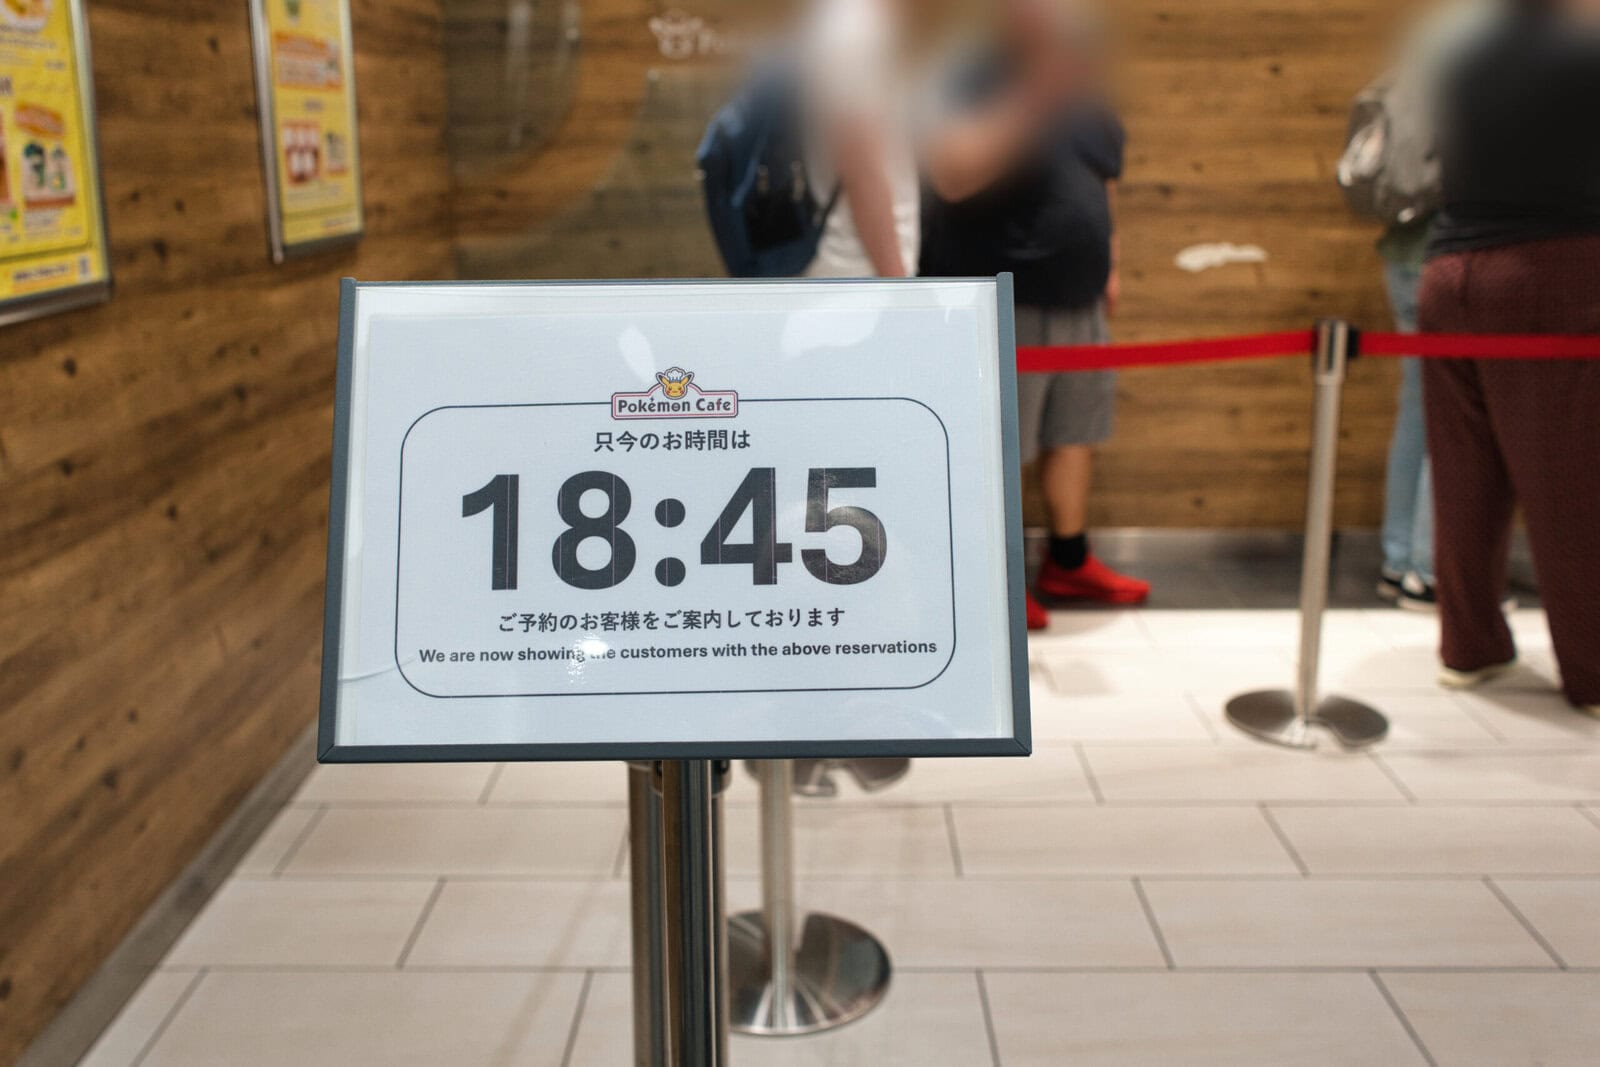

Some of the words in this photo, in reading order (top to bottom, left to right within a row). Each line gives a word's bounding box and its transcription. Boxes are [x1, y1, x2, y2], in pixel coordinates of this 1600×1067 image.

[618, 398, 691, 413] Pokémon
[695, 398, 731, 411] Cafe
[594, 429, 751, 452] 只今のお時間は
[462, 466, 888, 590] 18:45
[498, 607, 846, 633] ご予約のお客様をご案内しております
[419, 649, 446, 663] We
[449, 651, 475, 662] are
[479, 650, 514, 662] now
[620, 645, 708, 659] customers
[711, 643, 747, 658] with
[750, 642, 778, 656] the
[782, 641, 831, 656] above
[835, 640, 938, 655] reservations
